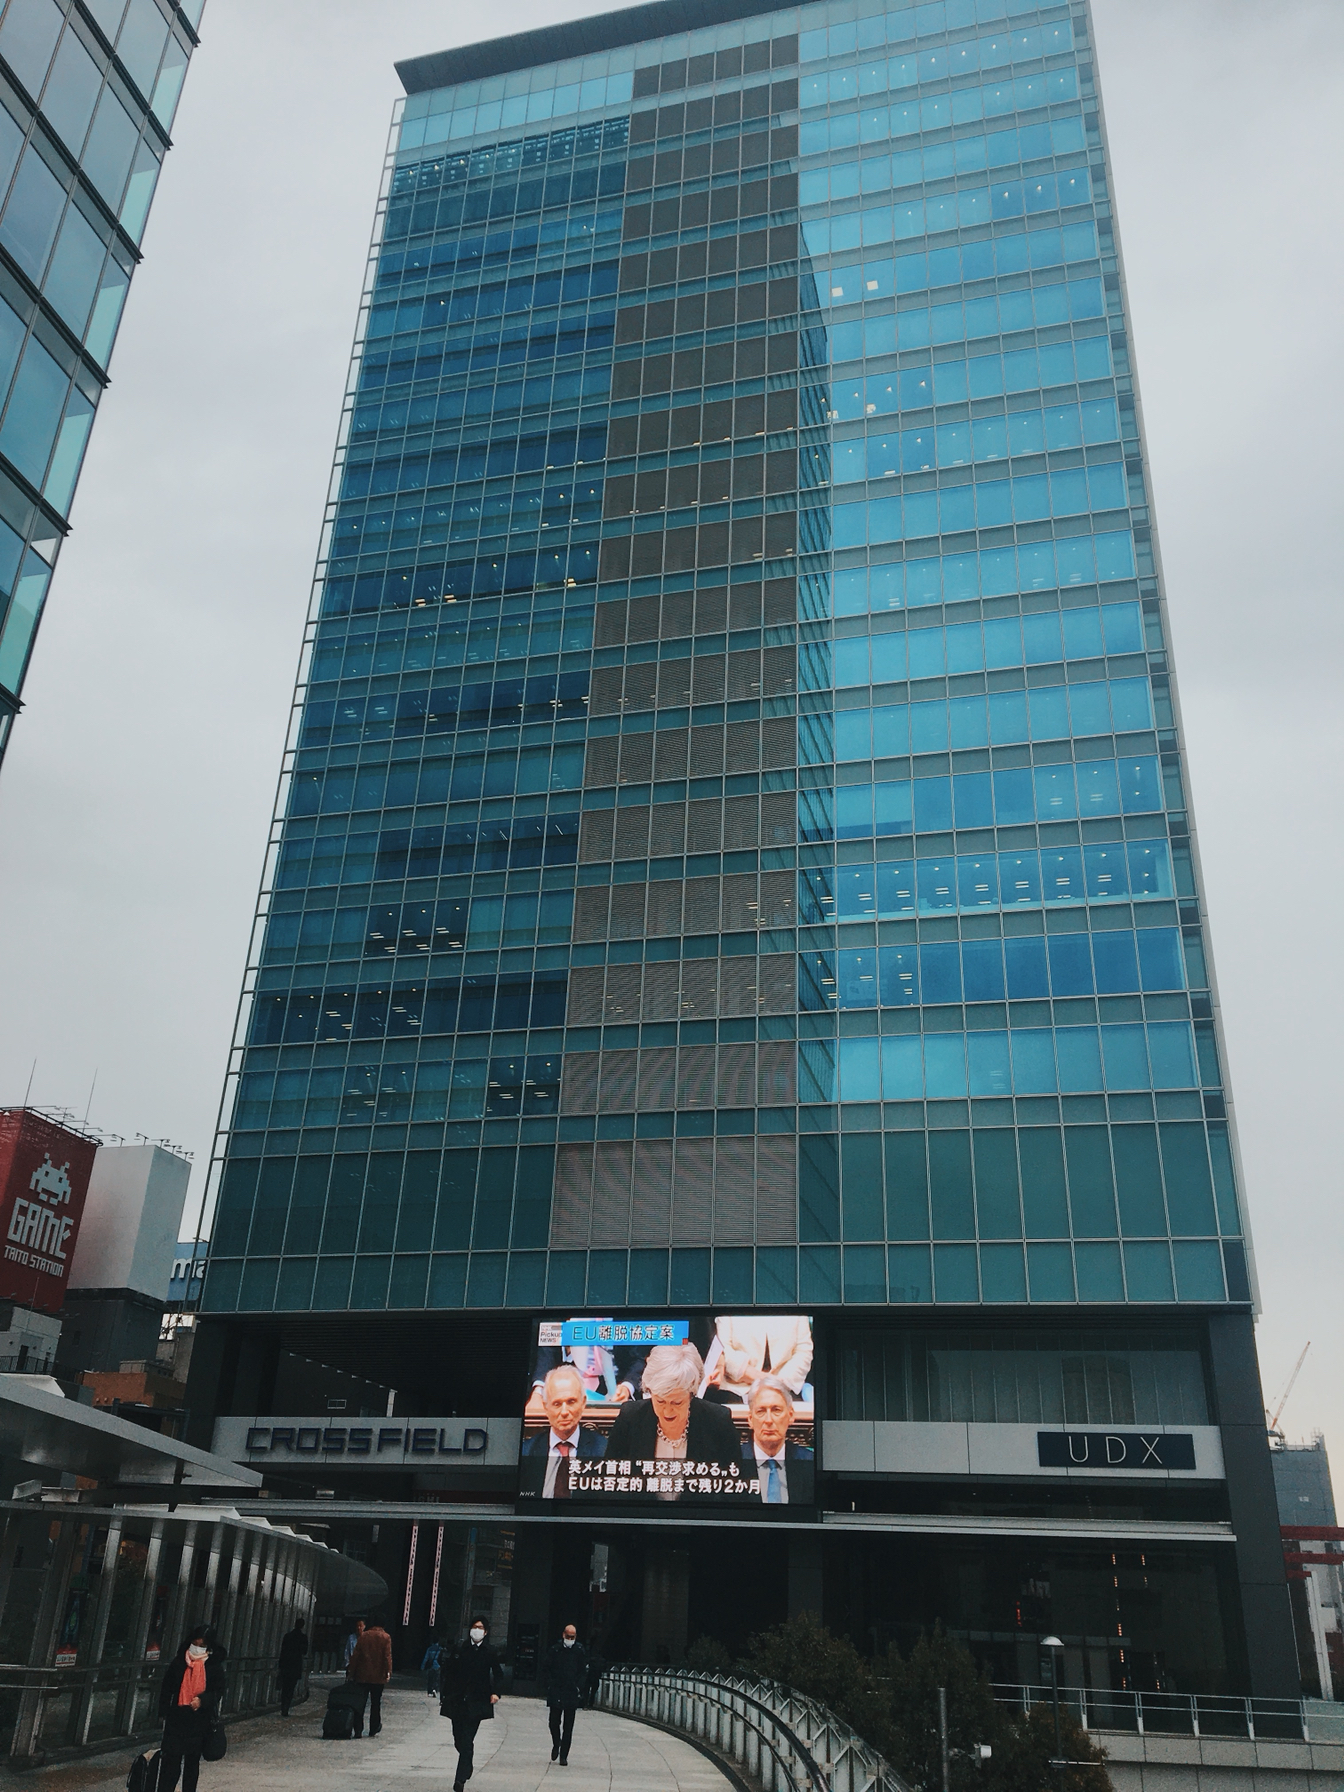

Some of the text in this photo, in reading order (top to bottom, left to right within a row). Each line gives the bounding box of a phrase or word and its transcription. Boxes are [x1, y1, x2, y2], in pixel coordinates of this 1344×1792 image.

[7, 1197, 74, 1260] GAME
[4, 1245, 64, 1277] TAITO STATION
[1068, 1435, 1163, 1465] UDX
